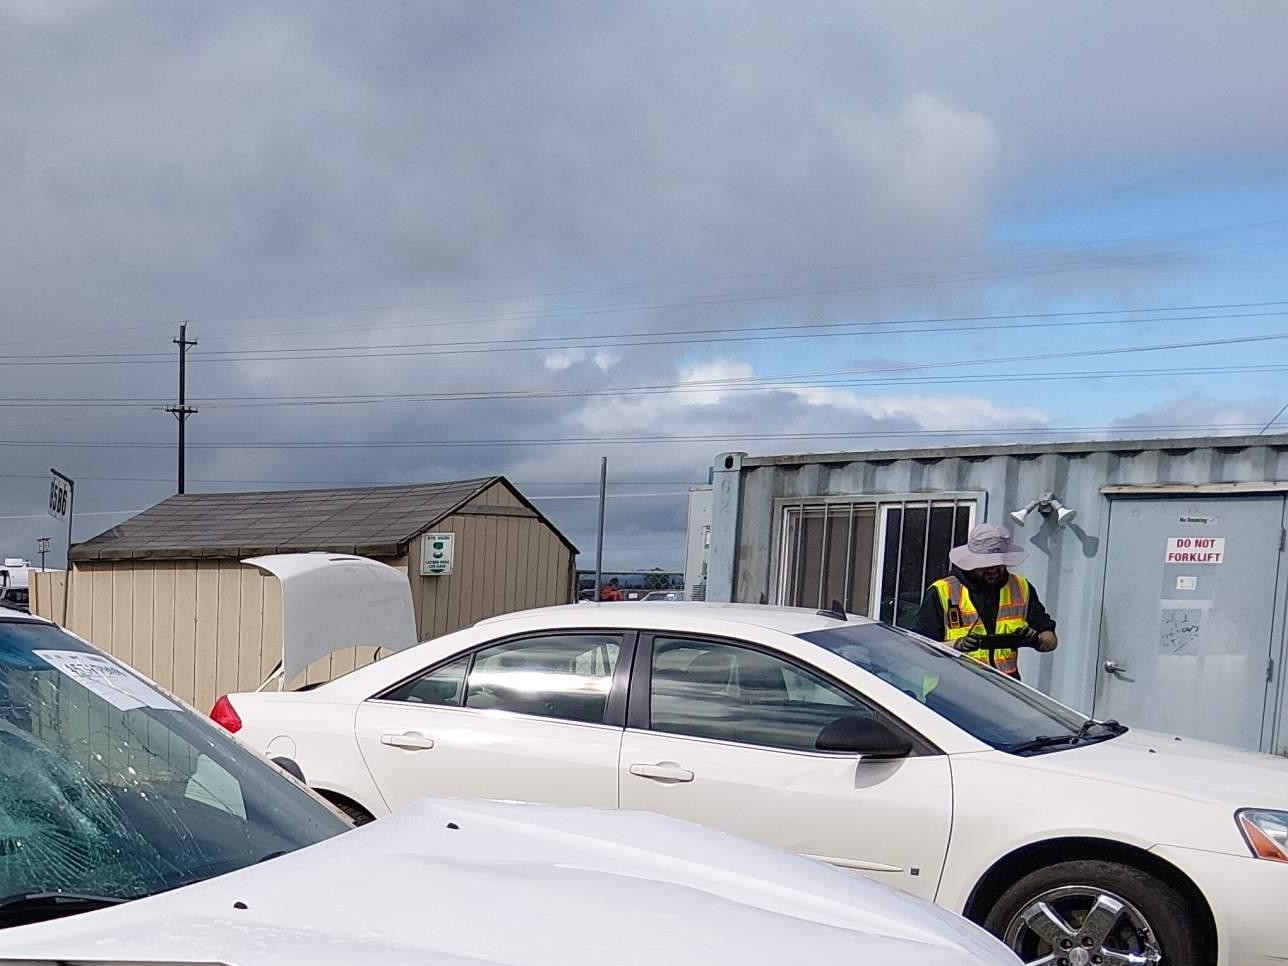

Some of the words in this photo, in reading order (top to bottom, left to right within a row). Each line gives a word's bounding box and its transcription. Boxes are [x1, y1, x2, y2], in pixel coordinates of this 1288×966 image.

[1176, 539, 1191, 548] DO
[1194, 539, 1216, 548] NOT
[1168, 553, 1221, 562] FORKLIFT
